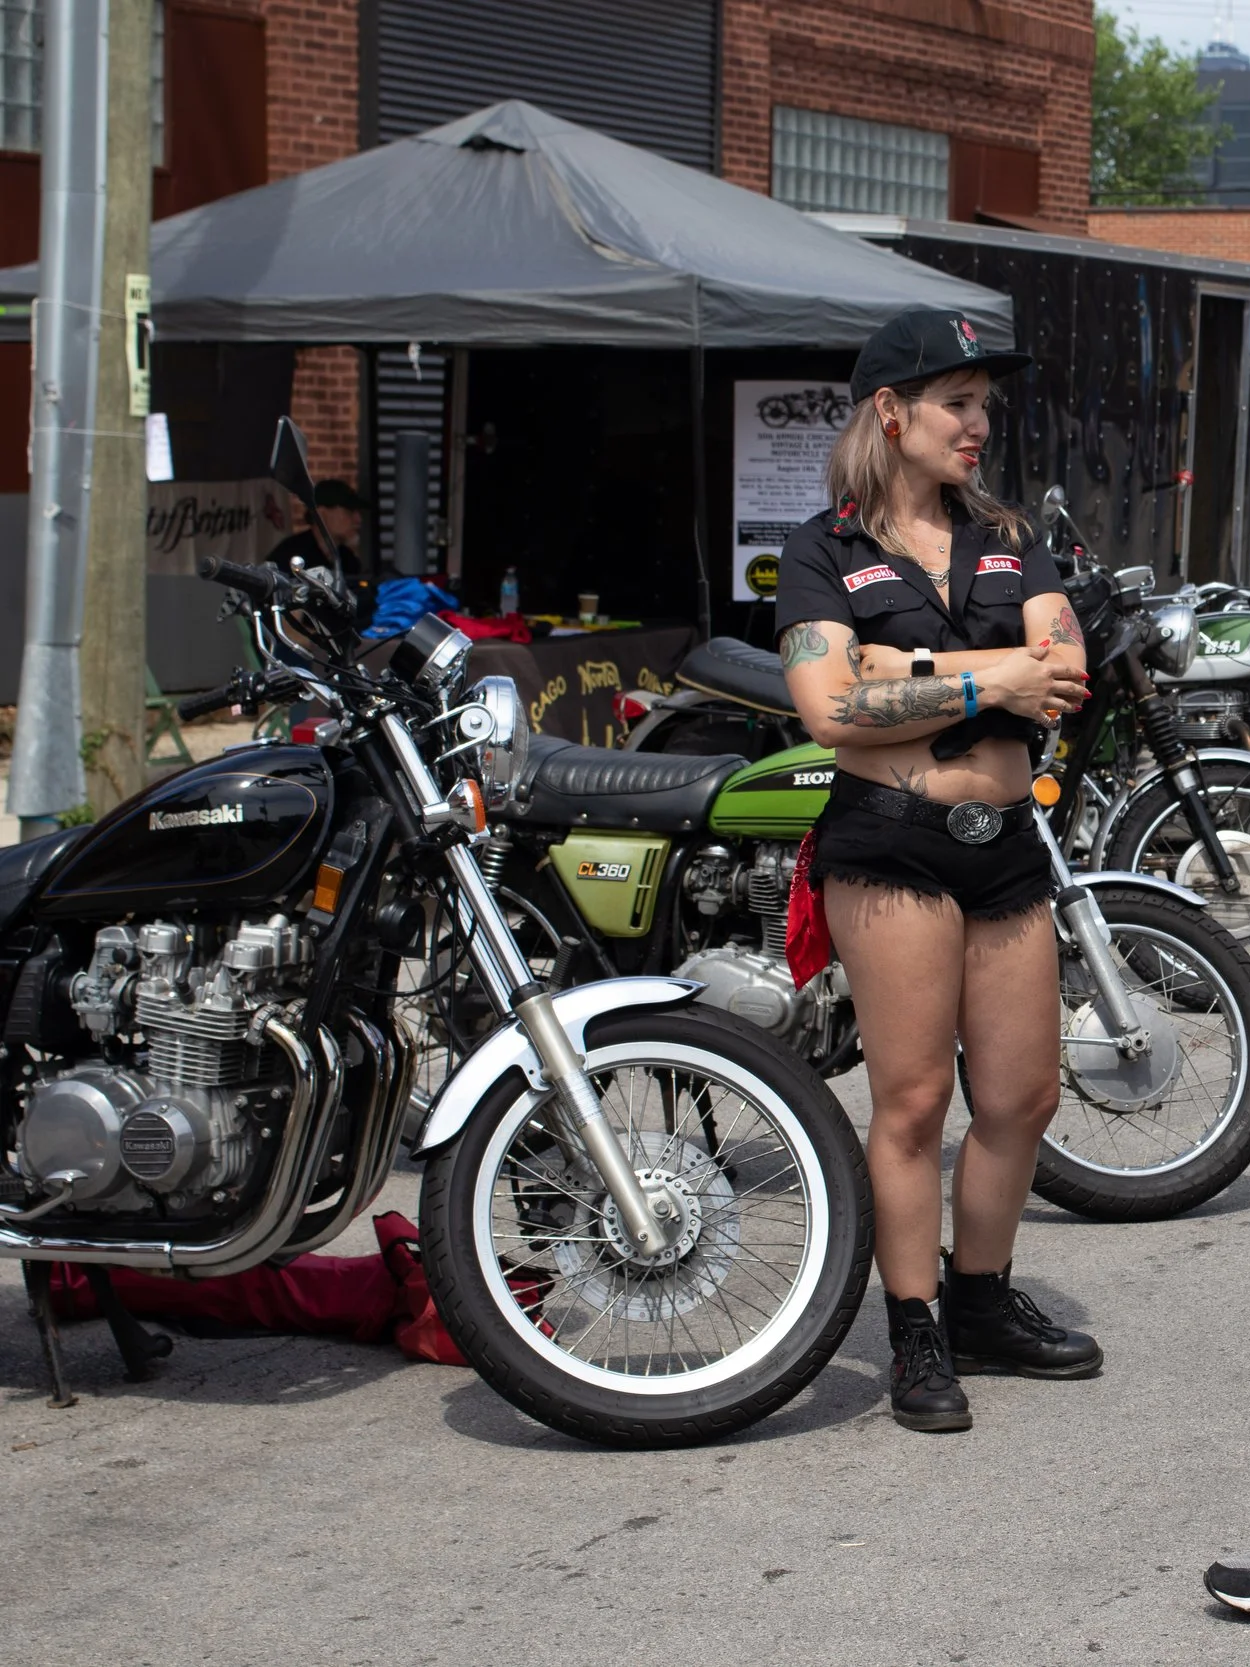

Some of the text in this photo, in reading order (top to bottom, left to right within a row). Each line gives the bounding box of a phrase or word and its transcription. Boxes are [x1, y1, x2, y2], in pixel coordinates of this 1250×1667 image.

[851, 558, 1014, 587] Brookly Rose
[1203, 639, 1241, 655] BSA
[793, 772, 835, 786] HON
[149, 803, 244, 831] Kawasaki
[577, 862, 631, 878] CL360
